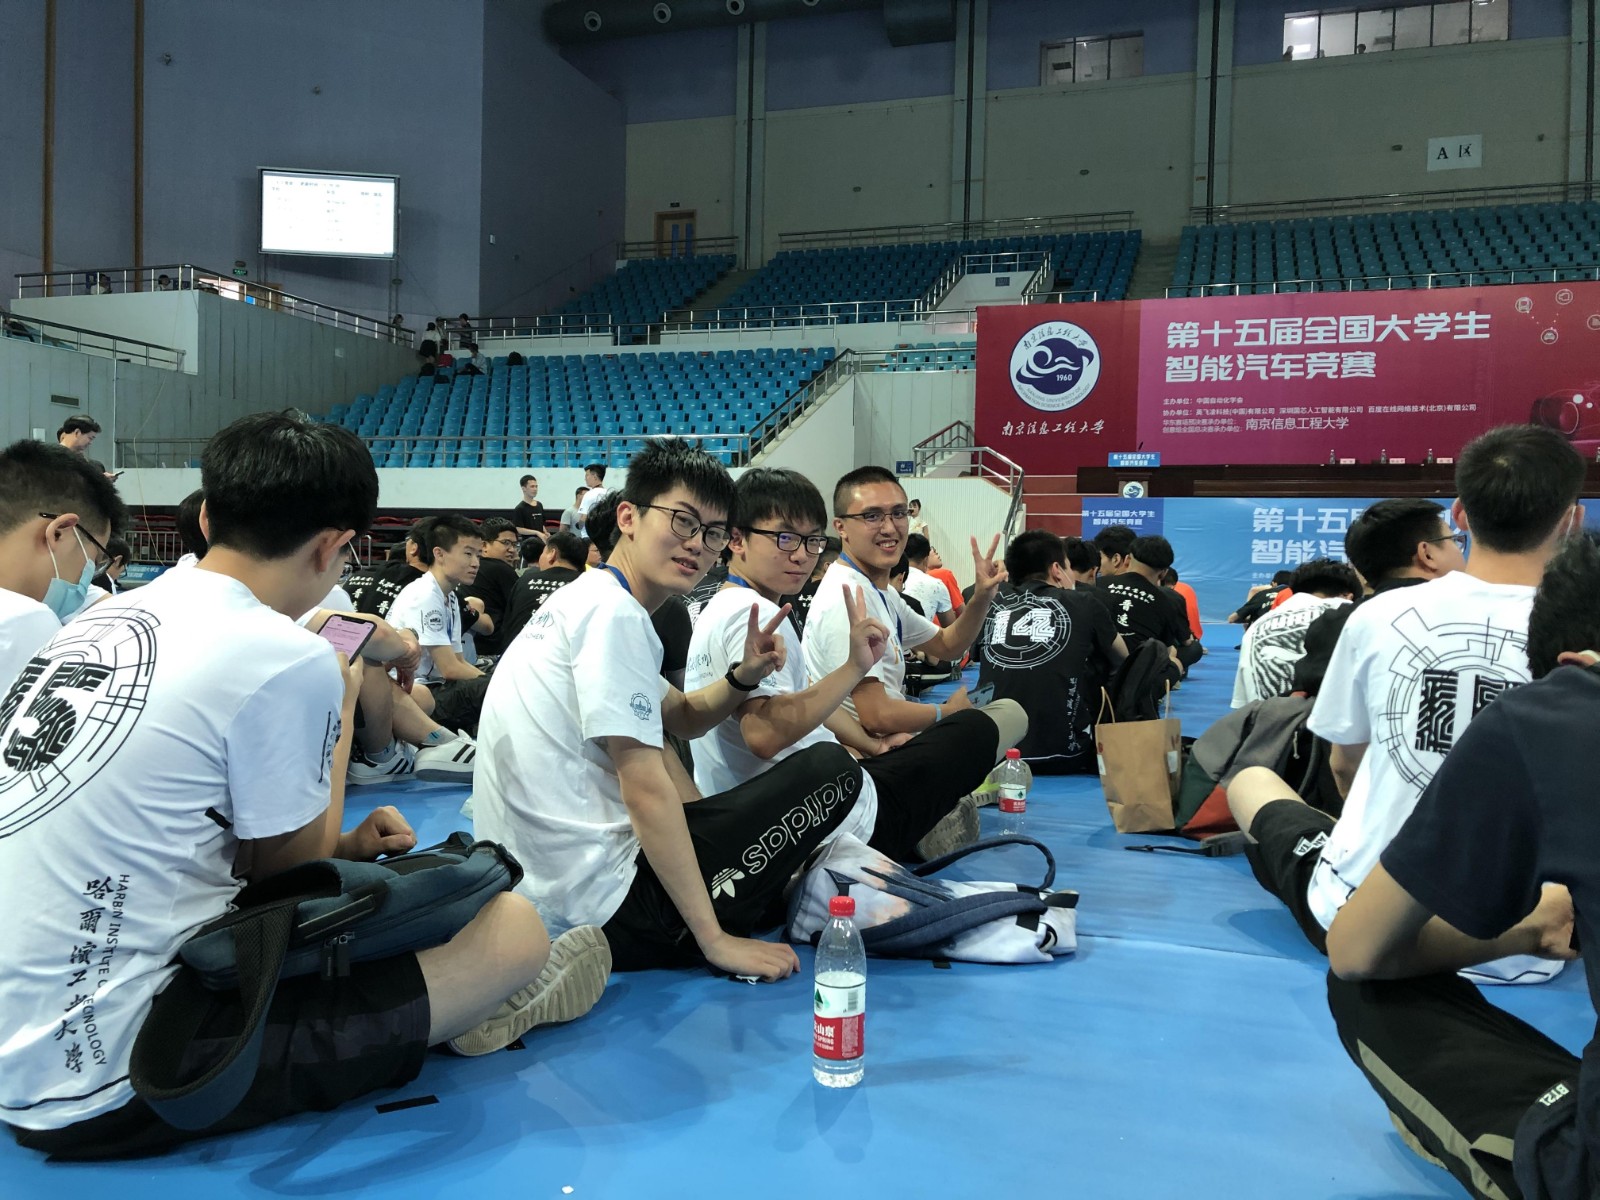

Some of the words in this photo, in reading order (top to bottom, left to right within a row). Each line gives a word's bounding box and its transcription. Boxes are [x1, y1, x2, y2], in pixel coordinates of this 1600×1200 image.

[1166, 311, 1492, 348] 第十五届全国大学生
[1165, 351, 1376, 382] 智能汽车竞赛
[1056, 374, 1072, 382] 1960
[1002, 419, 1105, 436] 南京信息工程大学
[1245, 417, 1349, 430] 南京信息工程大学
[1539, 1083, 1570, 1106] BT21
